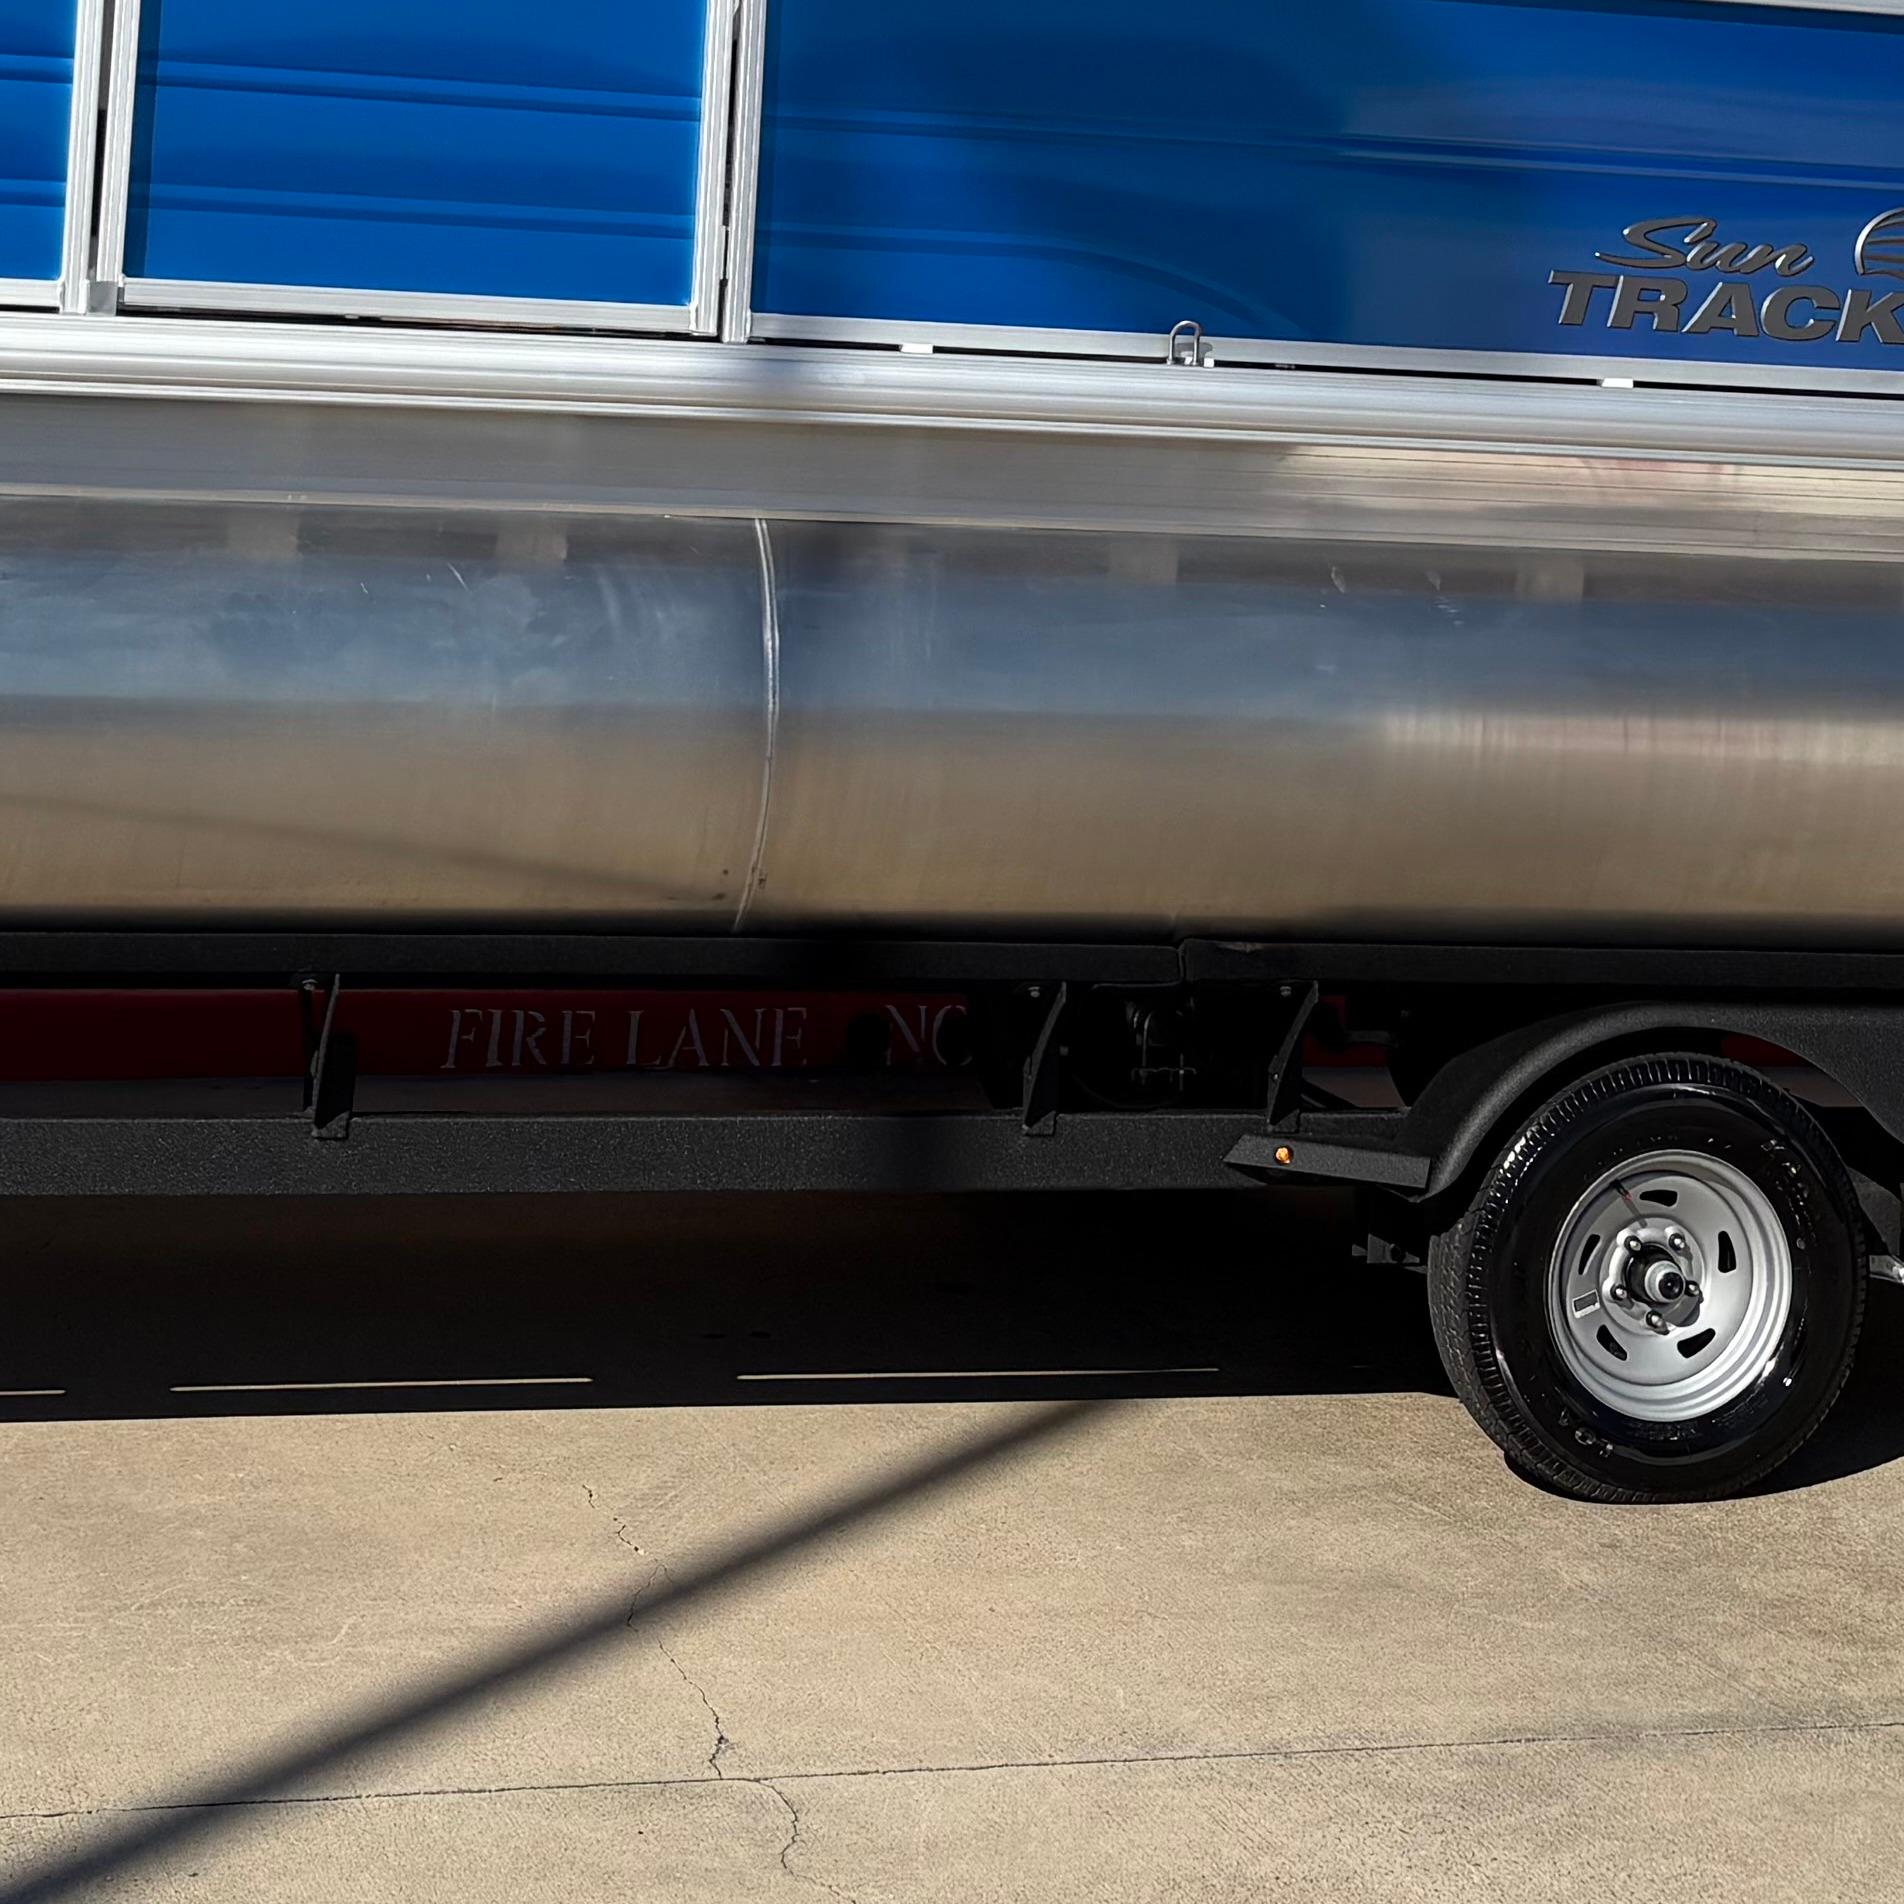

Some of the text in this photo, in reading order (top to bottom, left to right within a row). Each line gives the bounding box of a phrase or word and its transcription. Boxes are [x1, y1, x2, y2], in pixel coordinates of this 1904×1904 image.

[1595, 215, 1815, 277] Sun
[440, 1008, 596, 1069] FIRE
[625, 1007, 807, 1070] LANE
